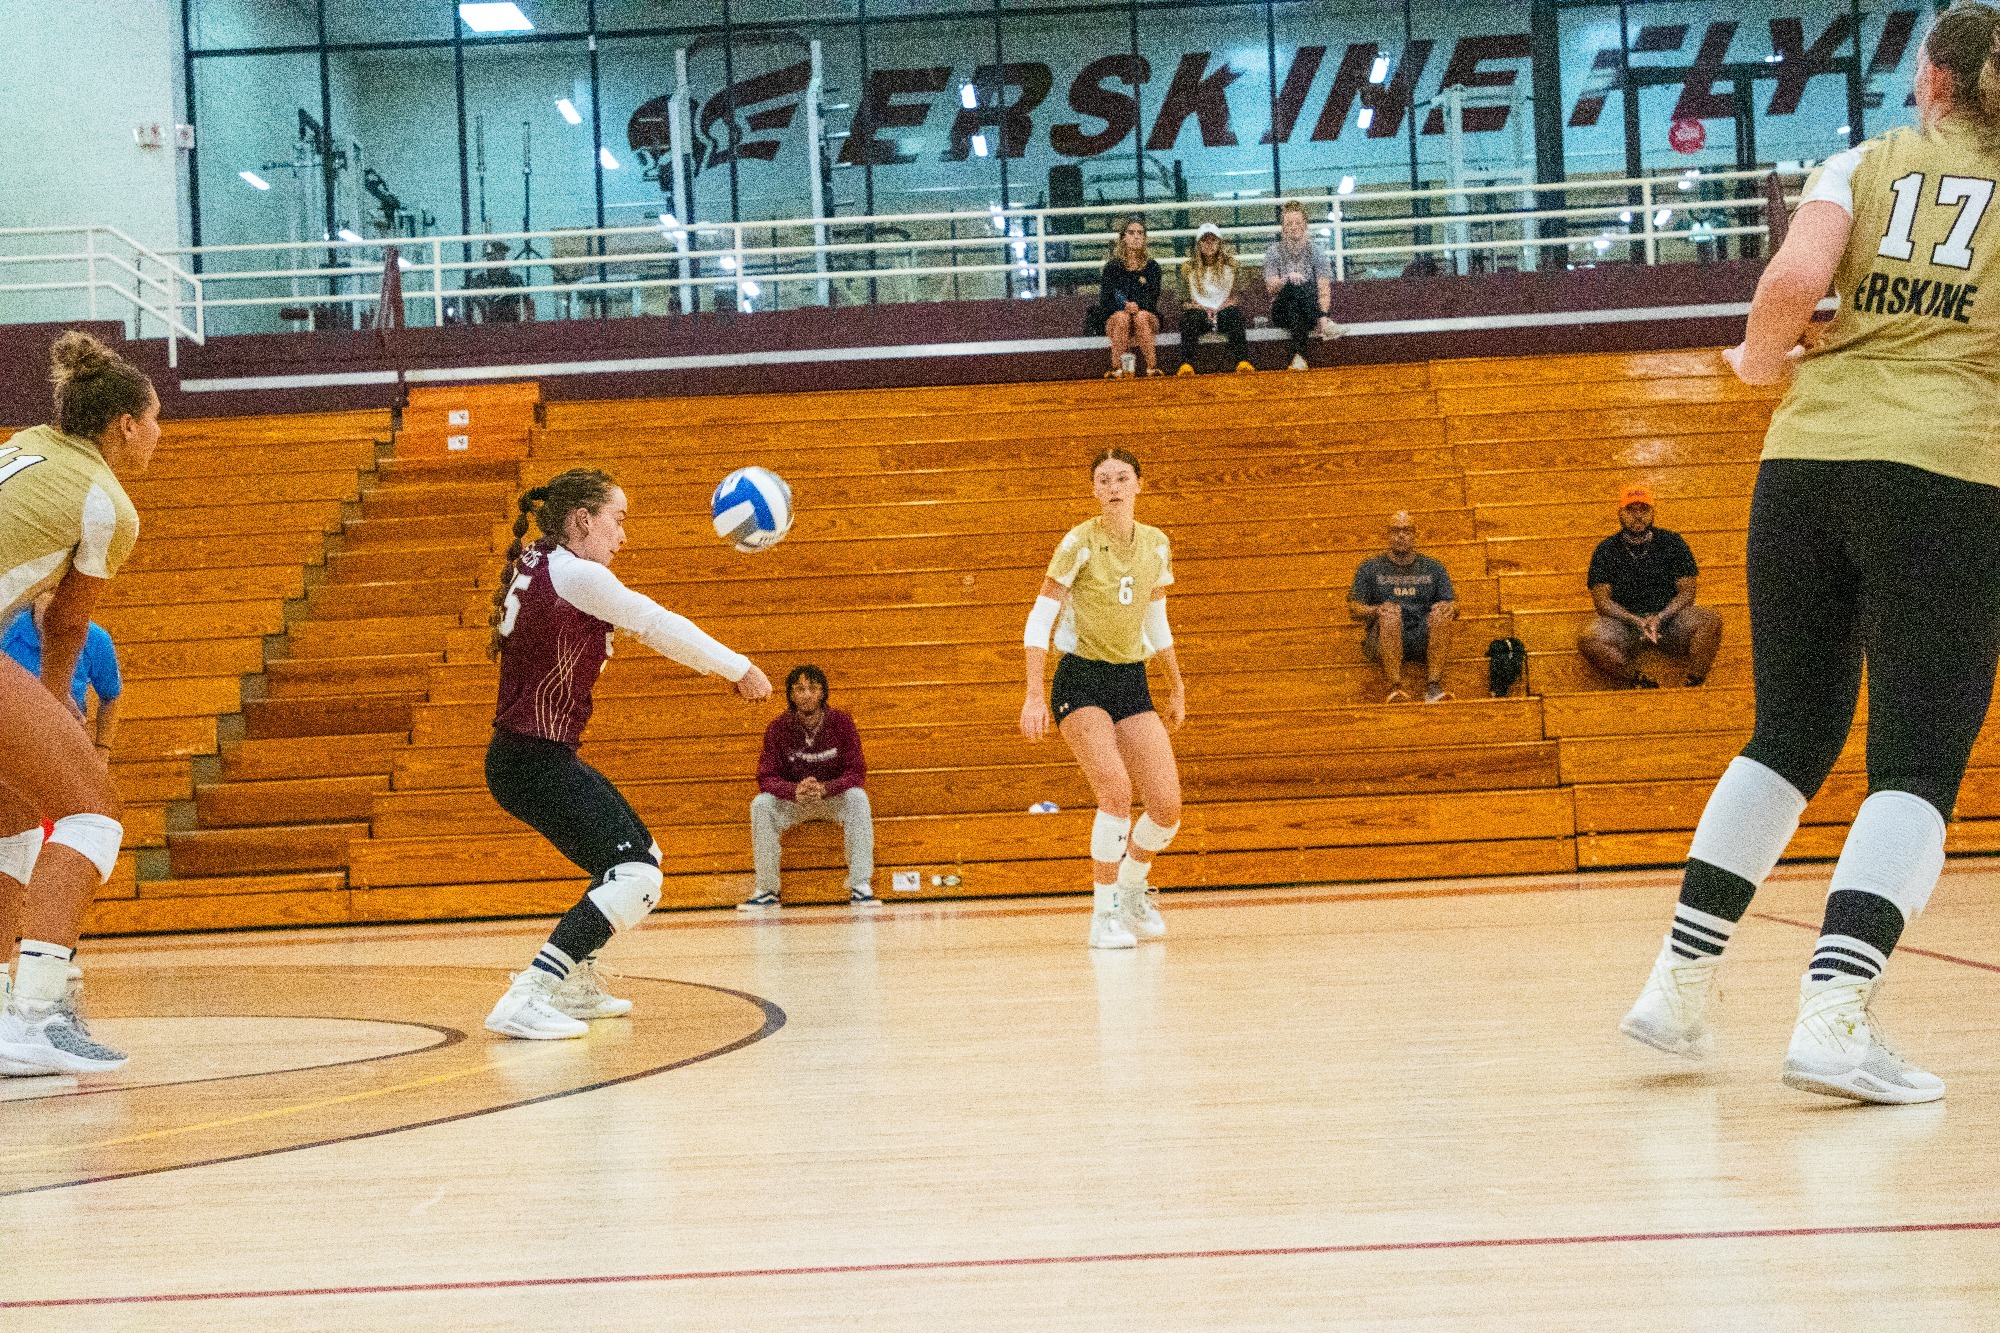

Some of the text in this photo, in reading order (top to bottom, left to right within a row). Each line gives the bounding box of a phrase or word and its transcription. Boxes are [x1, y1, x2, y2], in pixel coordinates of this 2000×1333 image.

[837, 8, 1925, 166] ERSKINE FLYI
[1877, 170, 1997, 271] 17
[1118, 575, 1134, 606] 6
